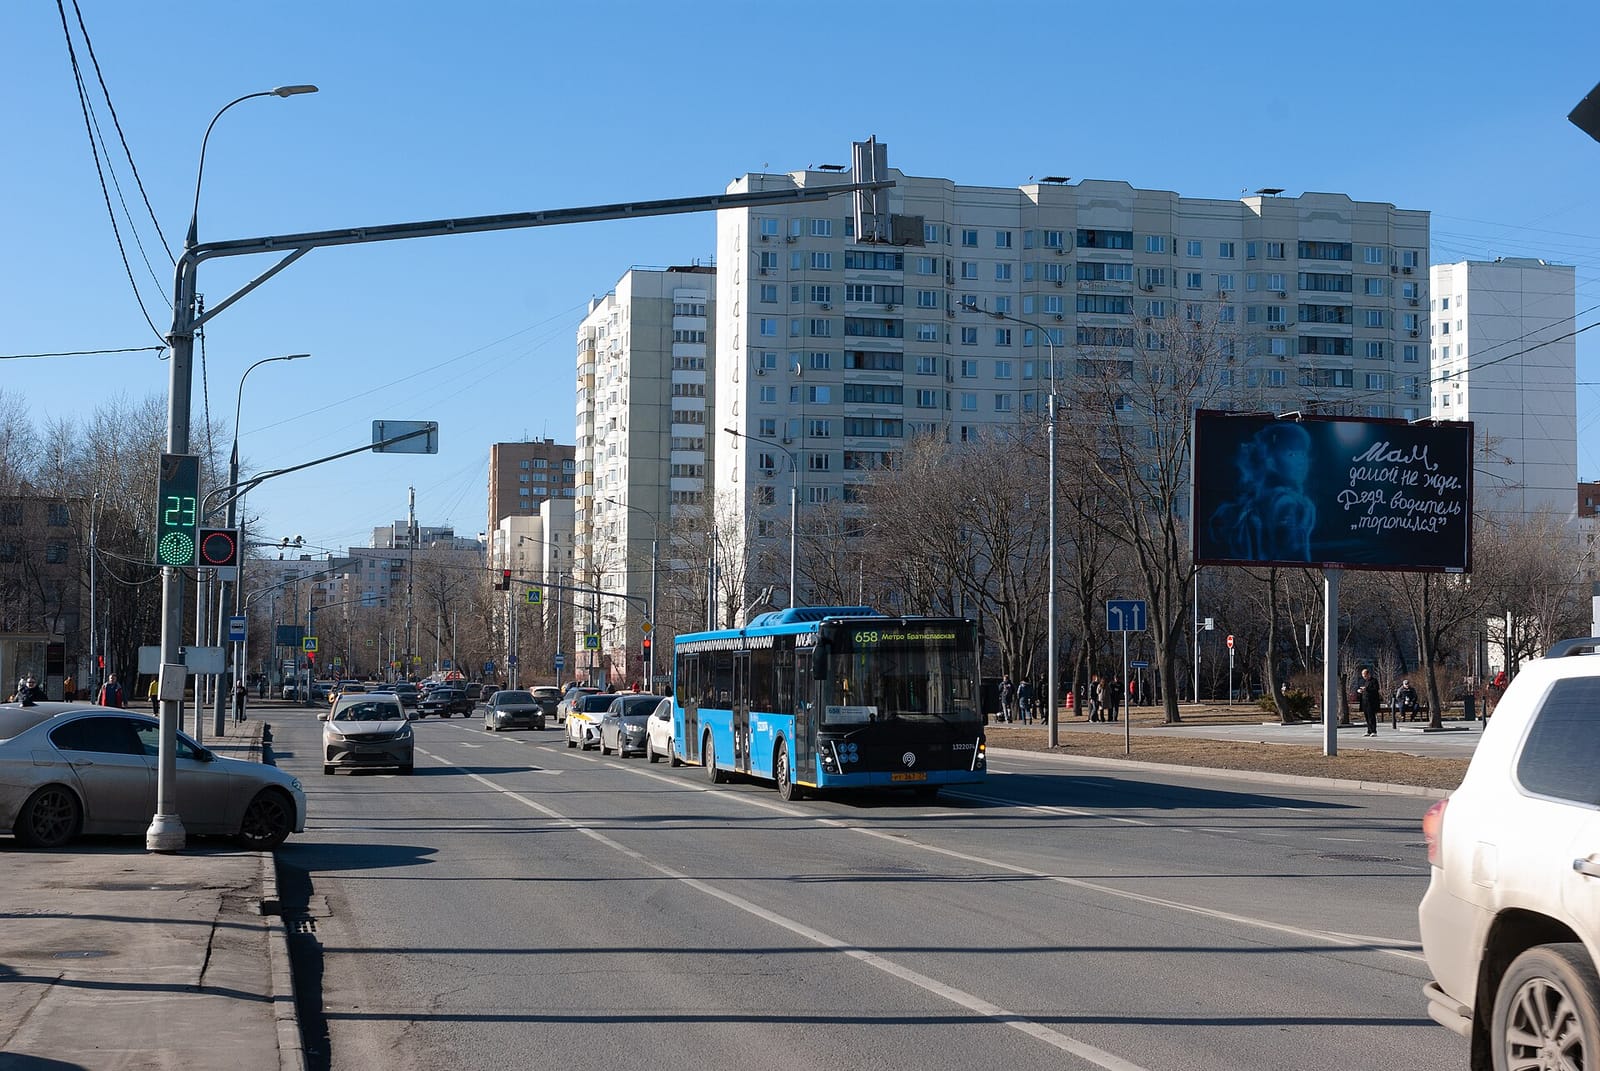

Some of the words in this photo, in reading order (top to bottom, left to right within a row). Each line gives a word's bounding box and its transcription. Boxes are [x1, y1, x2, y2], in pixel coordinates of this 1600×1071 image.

[1352, 441, 1439, 471] Мам,
[1401, 469, 1419, 486] не
[1423, 473, 1462, 496] жди.
[165, 496, 196, 527] 23
[1337, 489, 1387, 515] Дядя
[1390, 490, 1461, 517] водитель
[855, 631, 878, 643] 658
